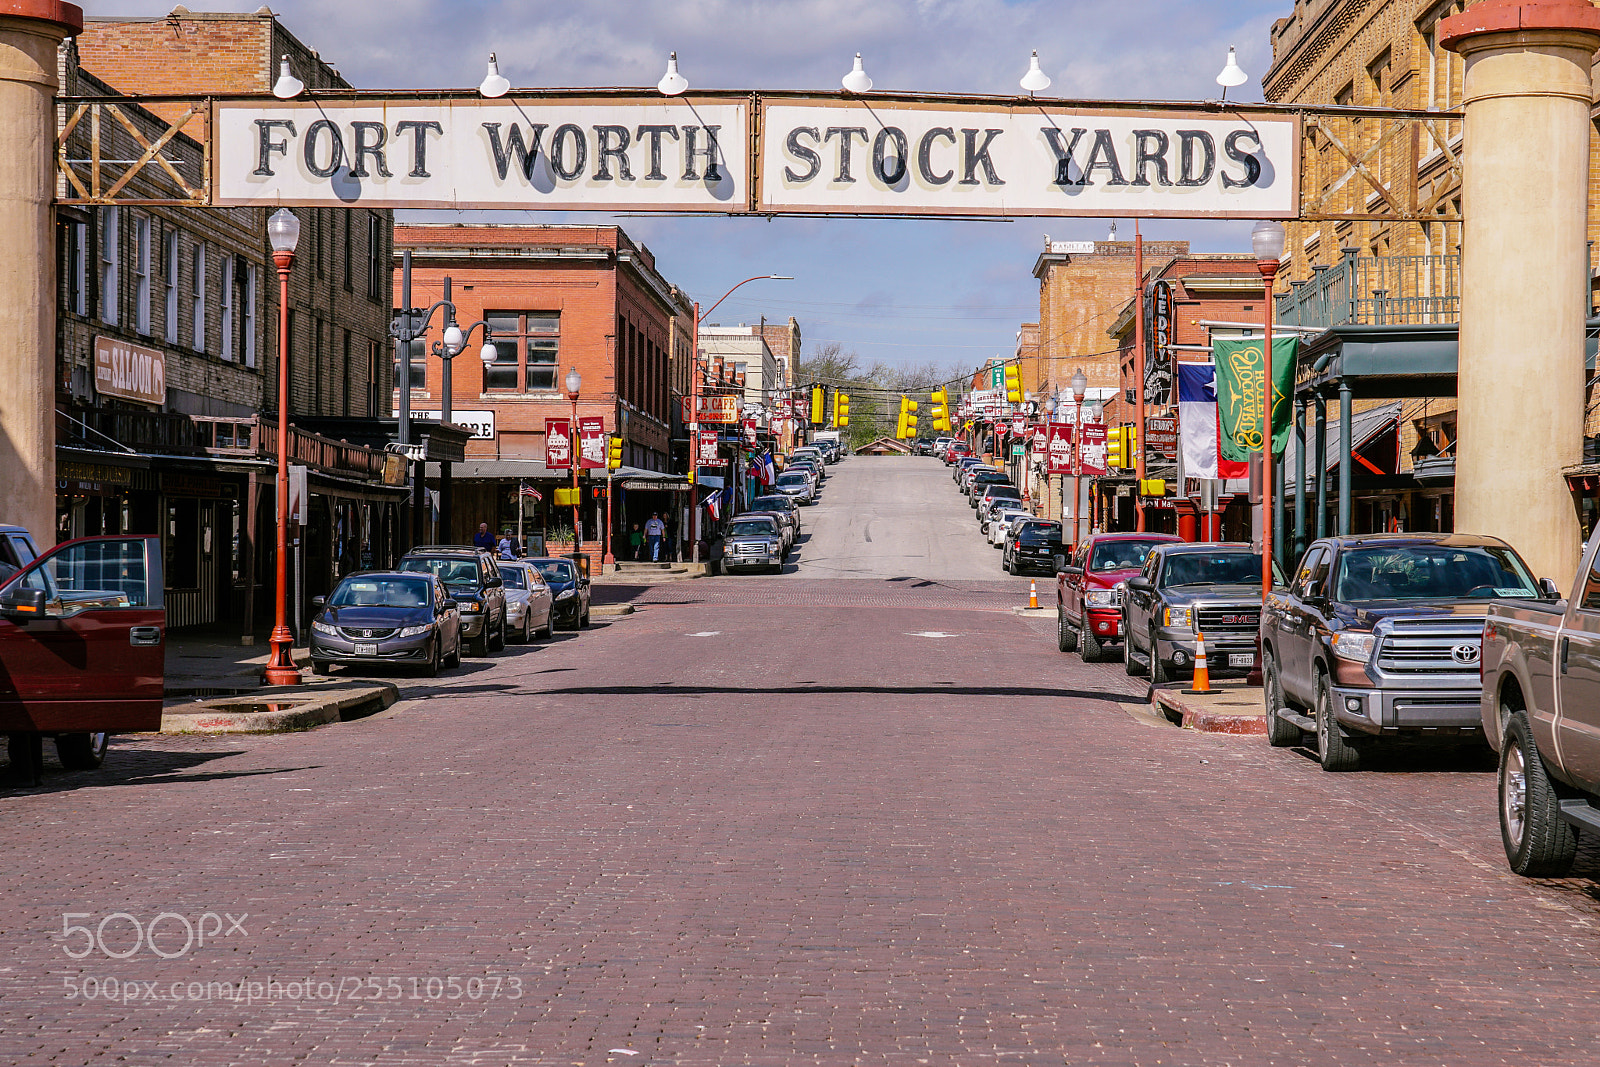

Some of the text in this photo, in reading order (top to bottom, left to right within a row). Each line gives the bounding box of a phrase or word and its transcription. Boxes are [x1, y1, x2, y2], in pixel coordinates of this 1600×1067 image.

[252, 119, 1263, 188] FORT WORTH STOCK YARDS
[1158, 284, 1168, 362] LEDDY
[112, 346, 152, 395] SALOON
[685, 398, 708, 410] SR
[712, 398, 735, 410] CAFE
[1154, 500, 1159, 508] N
[1222, 615, 1257, 623] GMC
